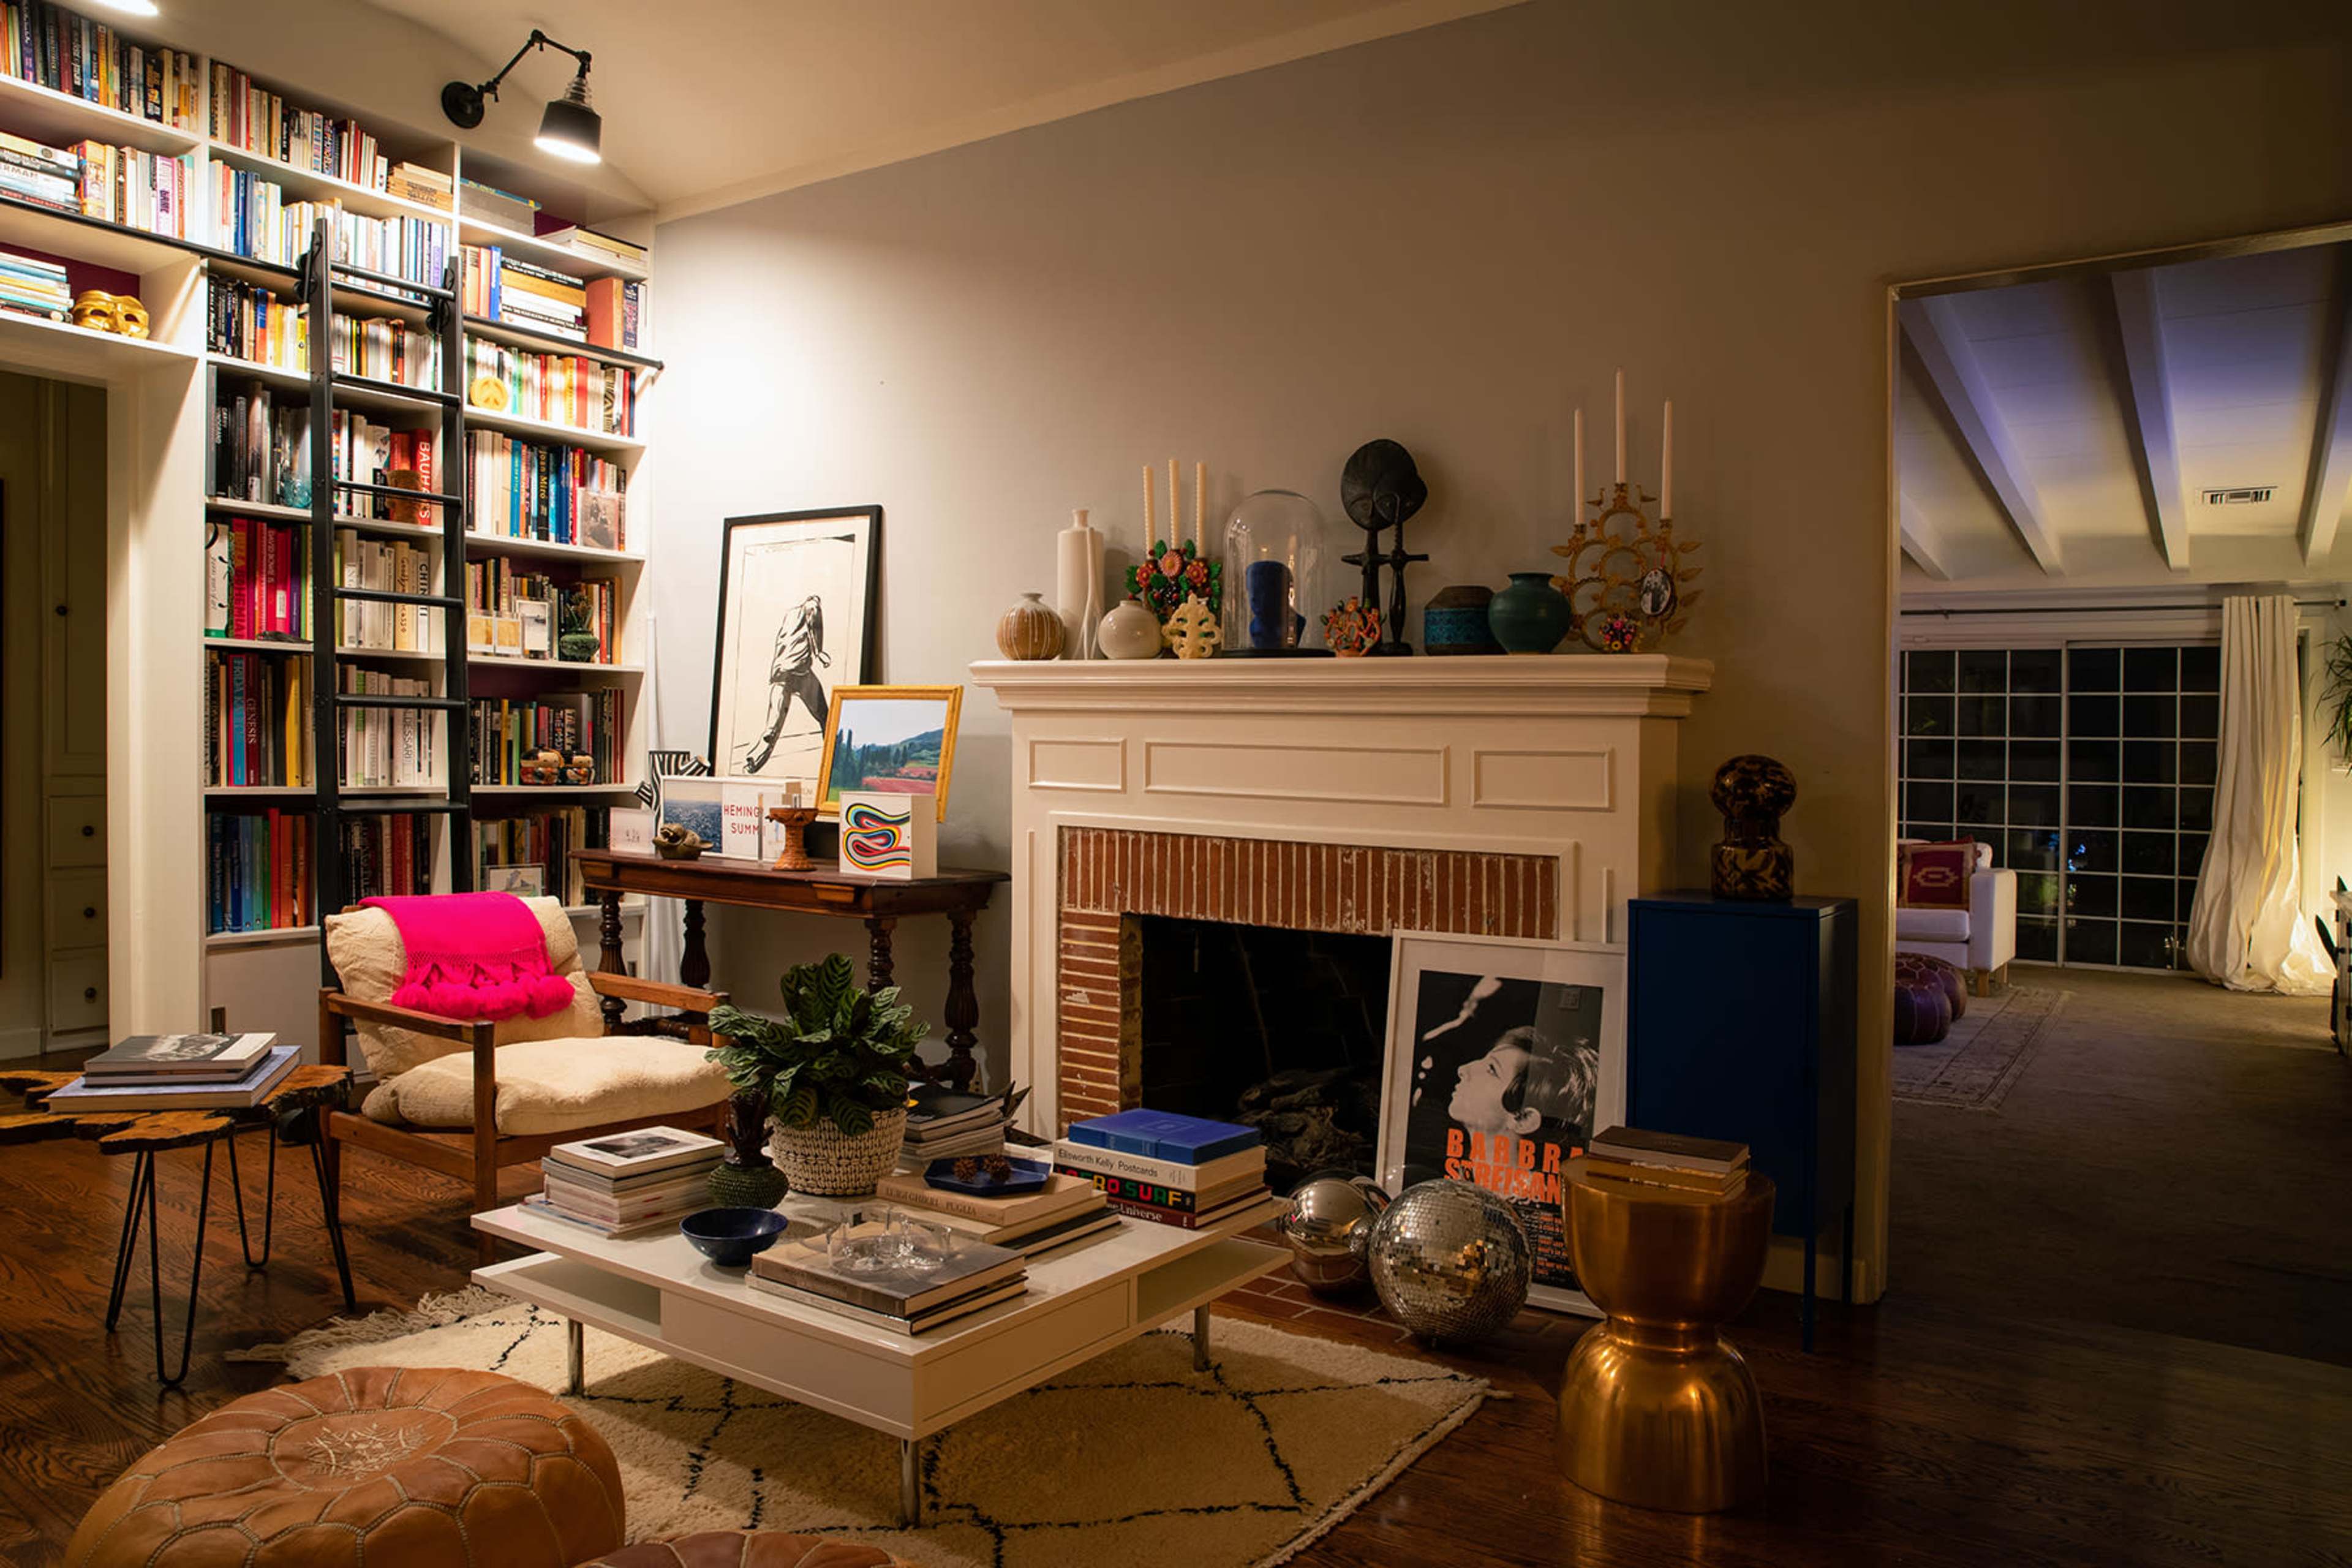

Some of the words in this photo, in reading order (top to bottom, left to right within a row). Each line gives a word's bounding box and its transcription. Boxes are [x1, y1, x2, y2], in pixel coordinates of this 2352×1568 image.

[538, 449, 548, 473] Joan
[419, 442, 431, 518] BAUHAS
[538, 475, 548, 499] Miró
[418, 564, 428, 616] CHINTI
[246, 698, 257, 744] GENESIS
[402, 710, 413, 760] LDESSARI
[731, 822, 761, 835] SUMM
[1058, 1148, 1095, 1164] Ellsworth
[1096, 1156, 1114, 1171] Kelly
[1118, 1160, 1158, 1178] Postcards
[1443, 1157, 1562, 1206] STREISAN
[945, 1201, 978, 1216] PUGLIA
[1120, 1202, 1163, 1221] Universe
